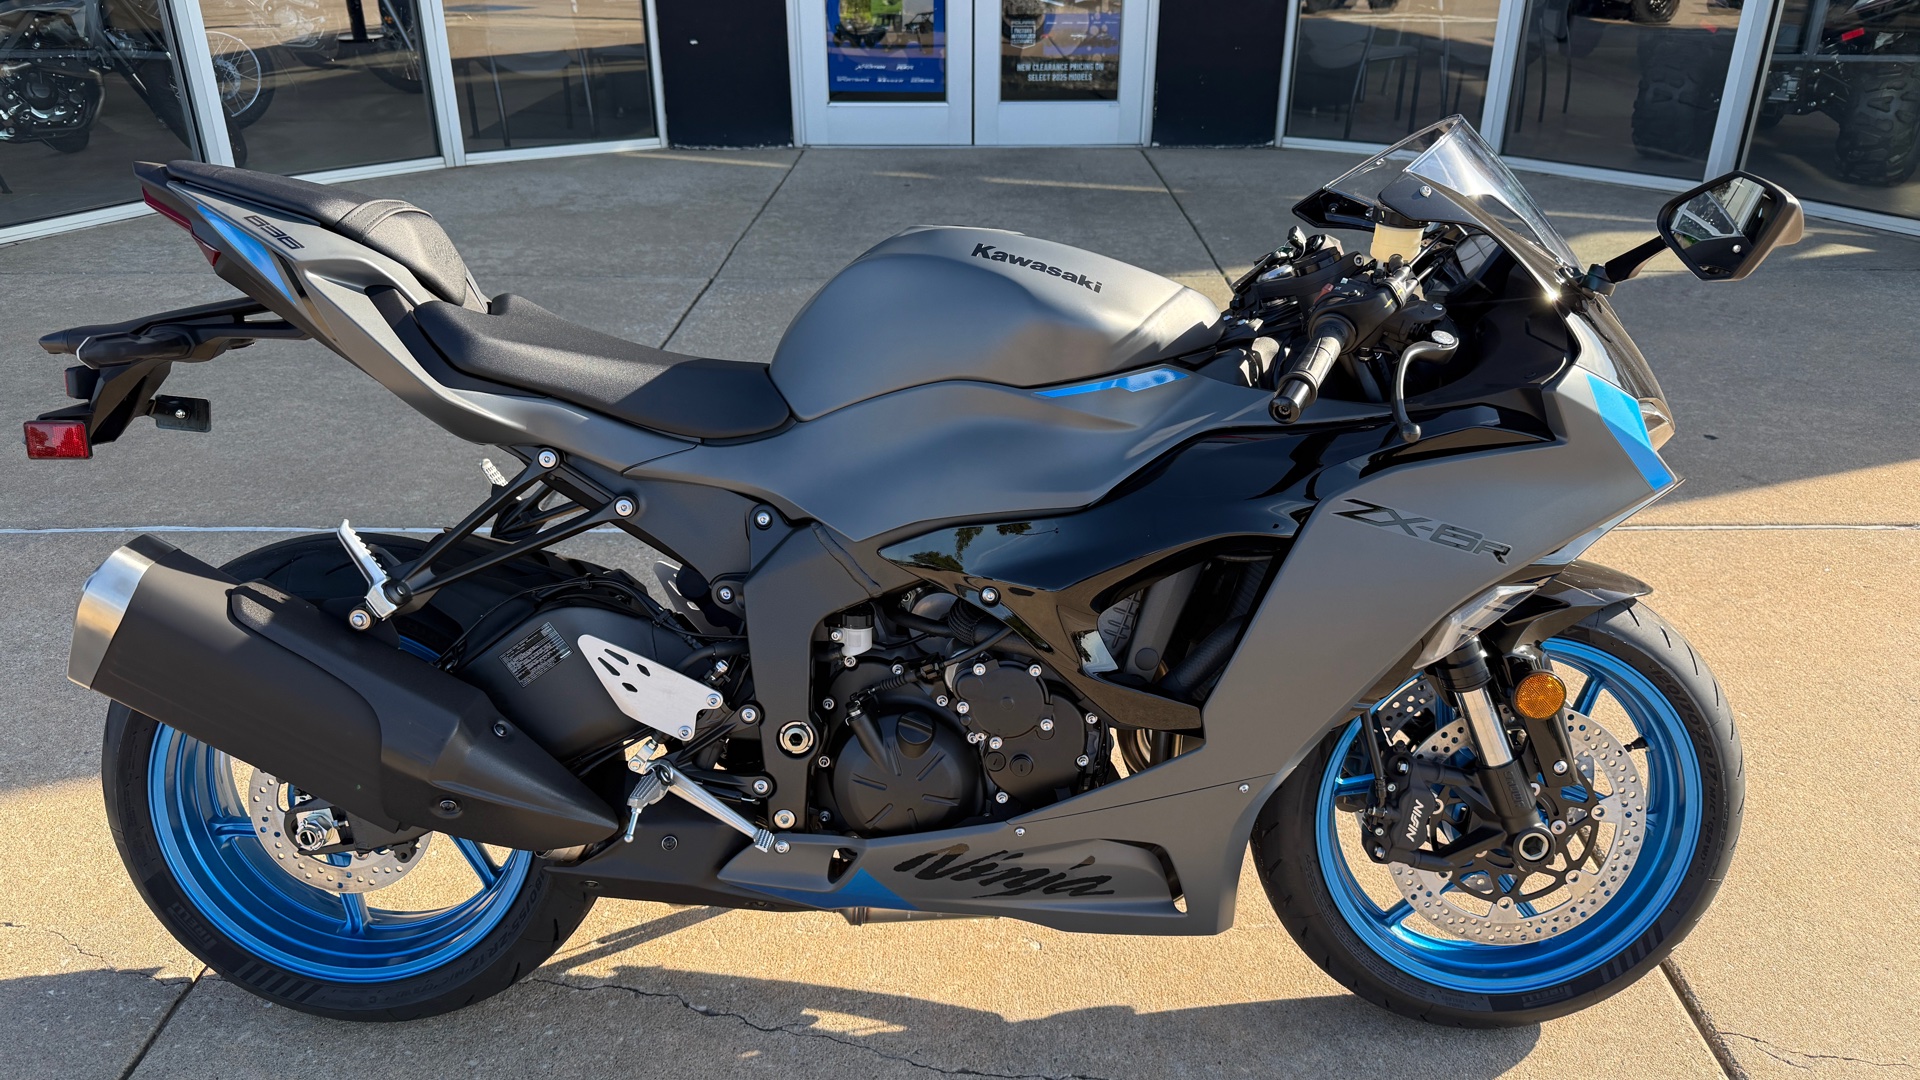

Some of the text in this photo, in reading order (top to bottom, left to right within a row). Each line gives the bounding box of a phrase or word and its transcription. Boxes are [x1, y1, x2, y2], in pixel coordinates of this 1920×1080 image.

[1016, 62, 1104, 71] NEW CLEARANCE PRICING ON
[1027, 73, 1093, 81] SELECT 2025 MODELS
[243, 215, 305, 249] 636
[971, 243, 1103, 293] Kawasaki
[1331, 498, 1512, 565] ZX-6R
[893, 842, 1115, 899] Ninja
